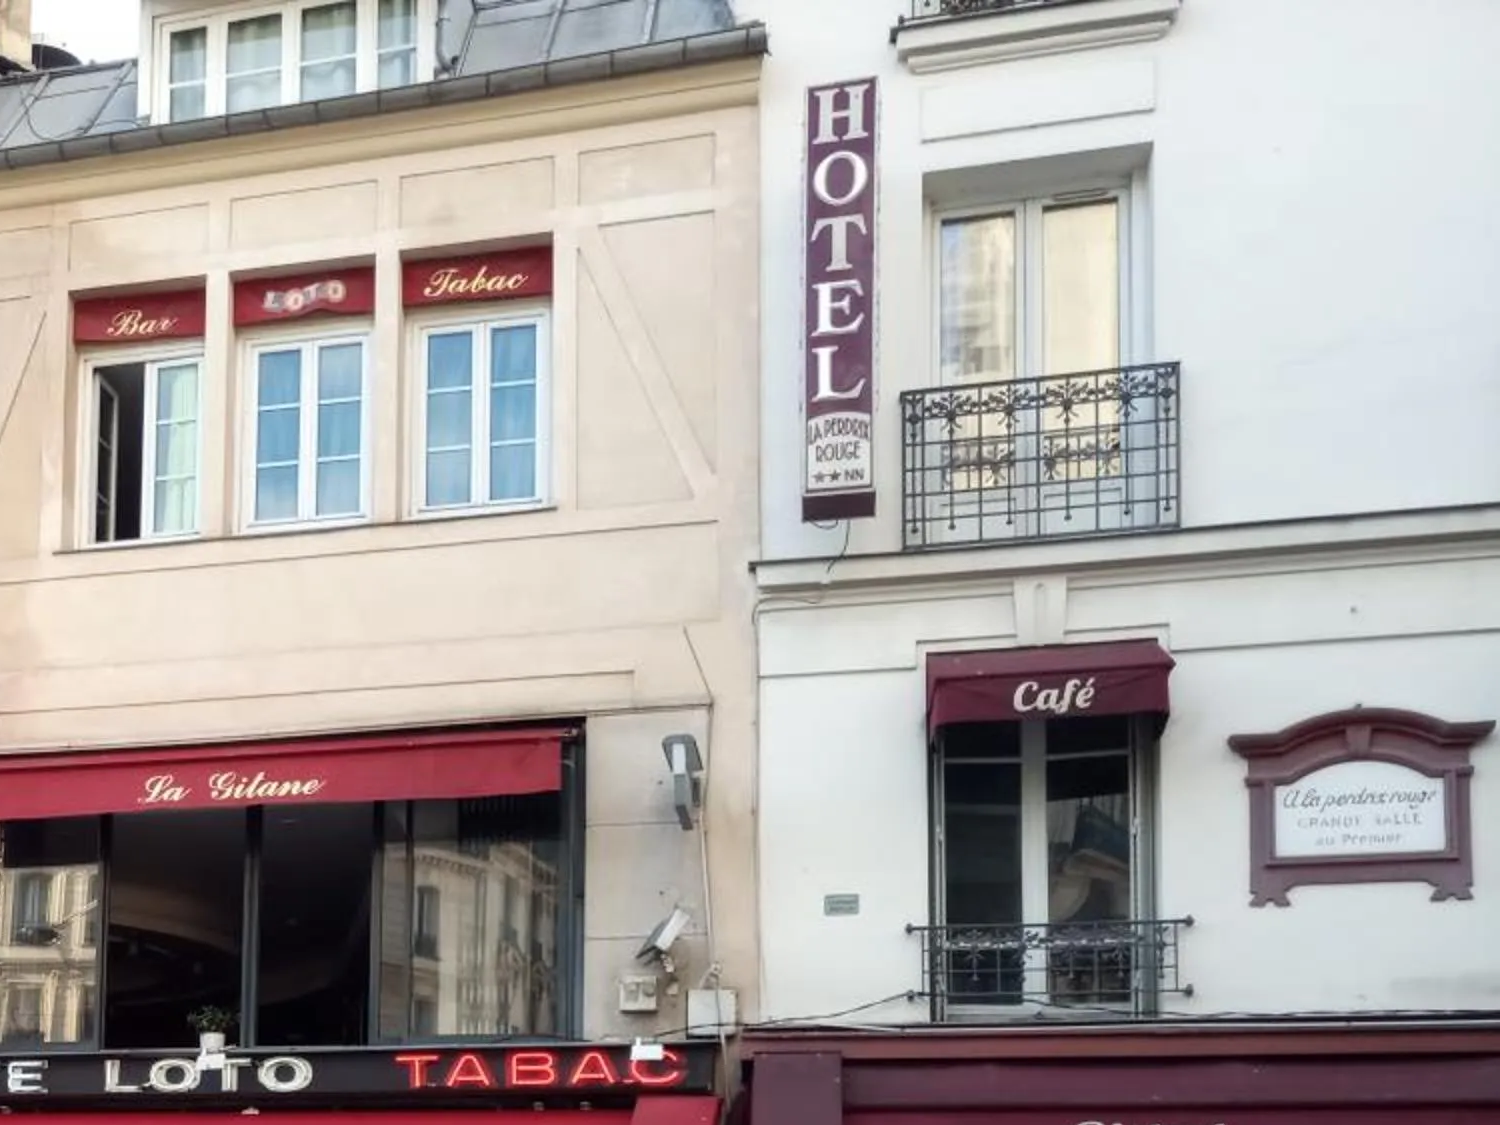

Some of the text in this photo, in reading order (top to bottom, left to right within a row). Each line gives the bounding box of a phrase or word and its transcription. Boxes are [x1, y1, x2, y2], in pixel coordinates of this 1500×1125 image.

[810, 82, 870, 402] HOTEL
[263, 279, 347, 313] LOTO
[423, 266, 529, 297] Tabac
[107, 309, 178, 337] Bar
[808, 417, 870, 445] LA PERDRIX
[815, 440, 861, 462] ROUGE
[1013, 677, 1096, 715] Café
[137, 770, 327, 805] La Gitane
[103, 1056, 313, 1093] LOTO
[393, 1050, 684, 1088] TABAC
